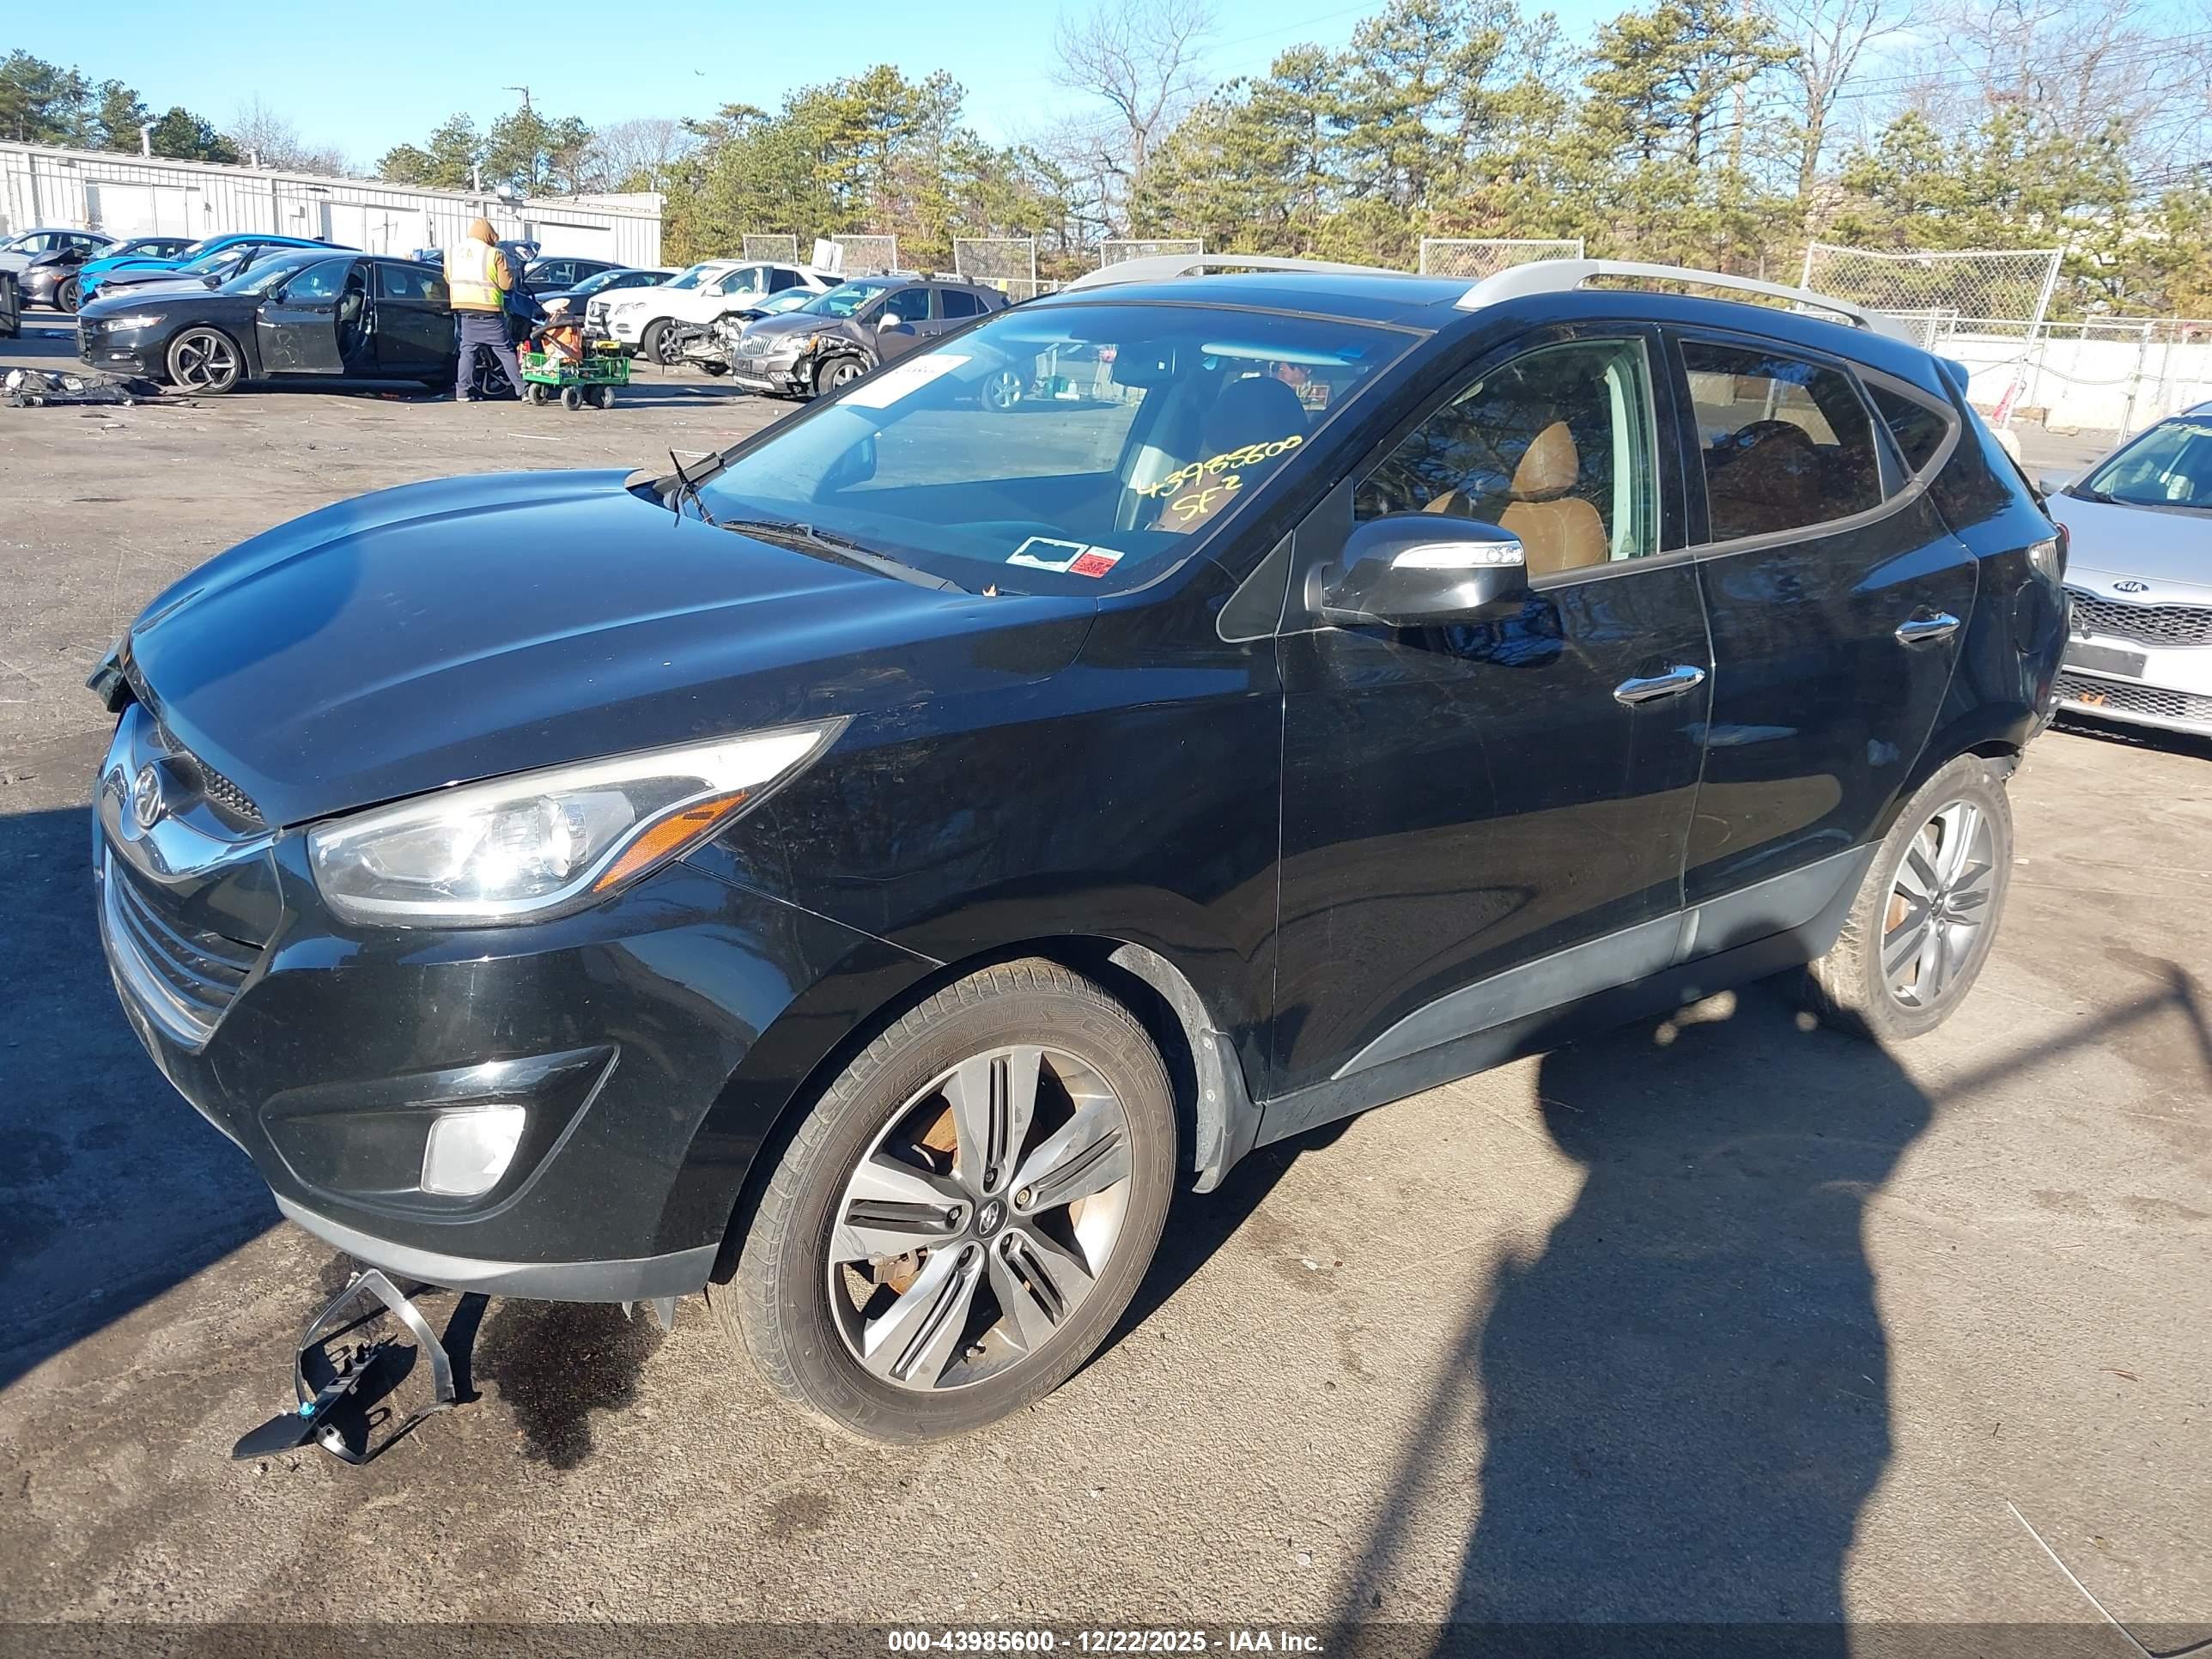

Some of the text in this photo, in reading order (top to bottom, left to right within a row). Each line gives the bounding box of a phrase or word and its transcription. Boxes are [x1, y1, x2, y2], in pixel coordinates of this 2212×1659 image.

[1137, 435, 1303, 499] 43985600
[1221, 474, 1243, 490] 2
[2117, 581, 2142, 592] KIA
